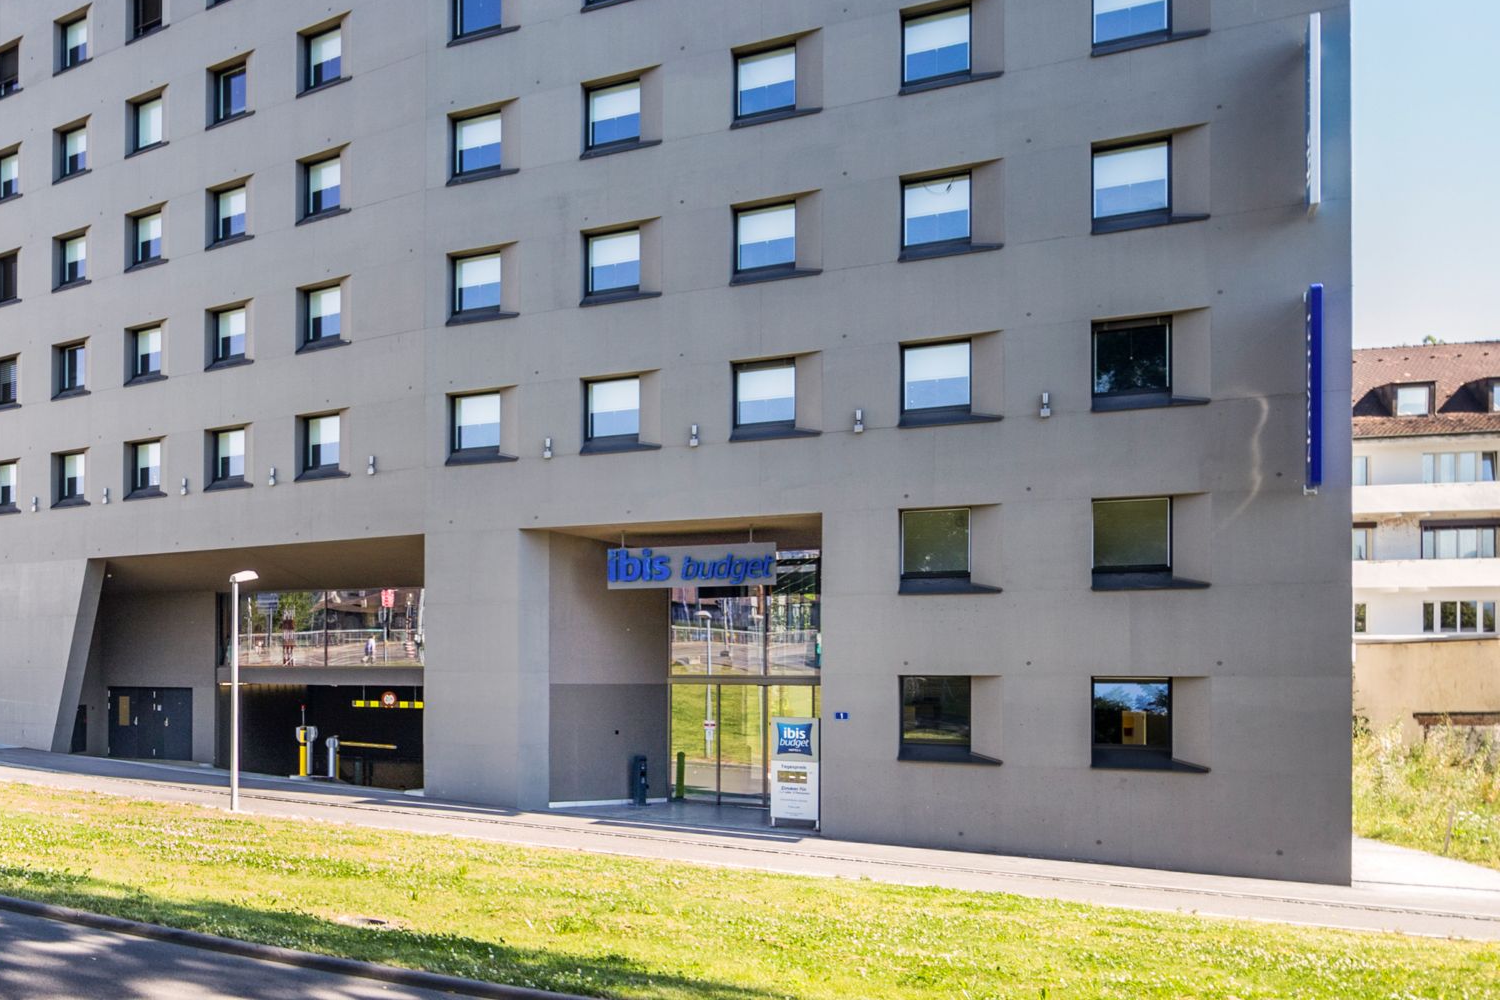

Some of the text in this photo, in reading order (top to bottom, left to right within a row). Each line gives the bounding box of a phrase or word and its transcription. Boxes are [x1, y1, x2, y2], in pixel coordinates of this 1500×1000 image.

[608, 548, 775, 585] ibis budget
[783, 727, 806, 739] ibis
[780, 737, 809, 748] budget
